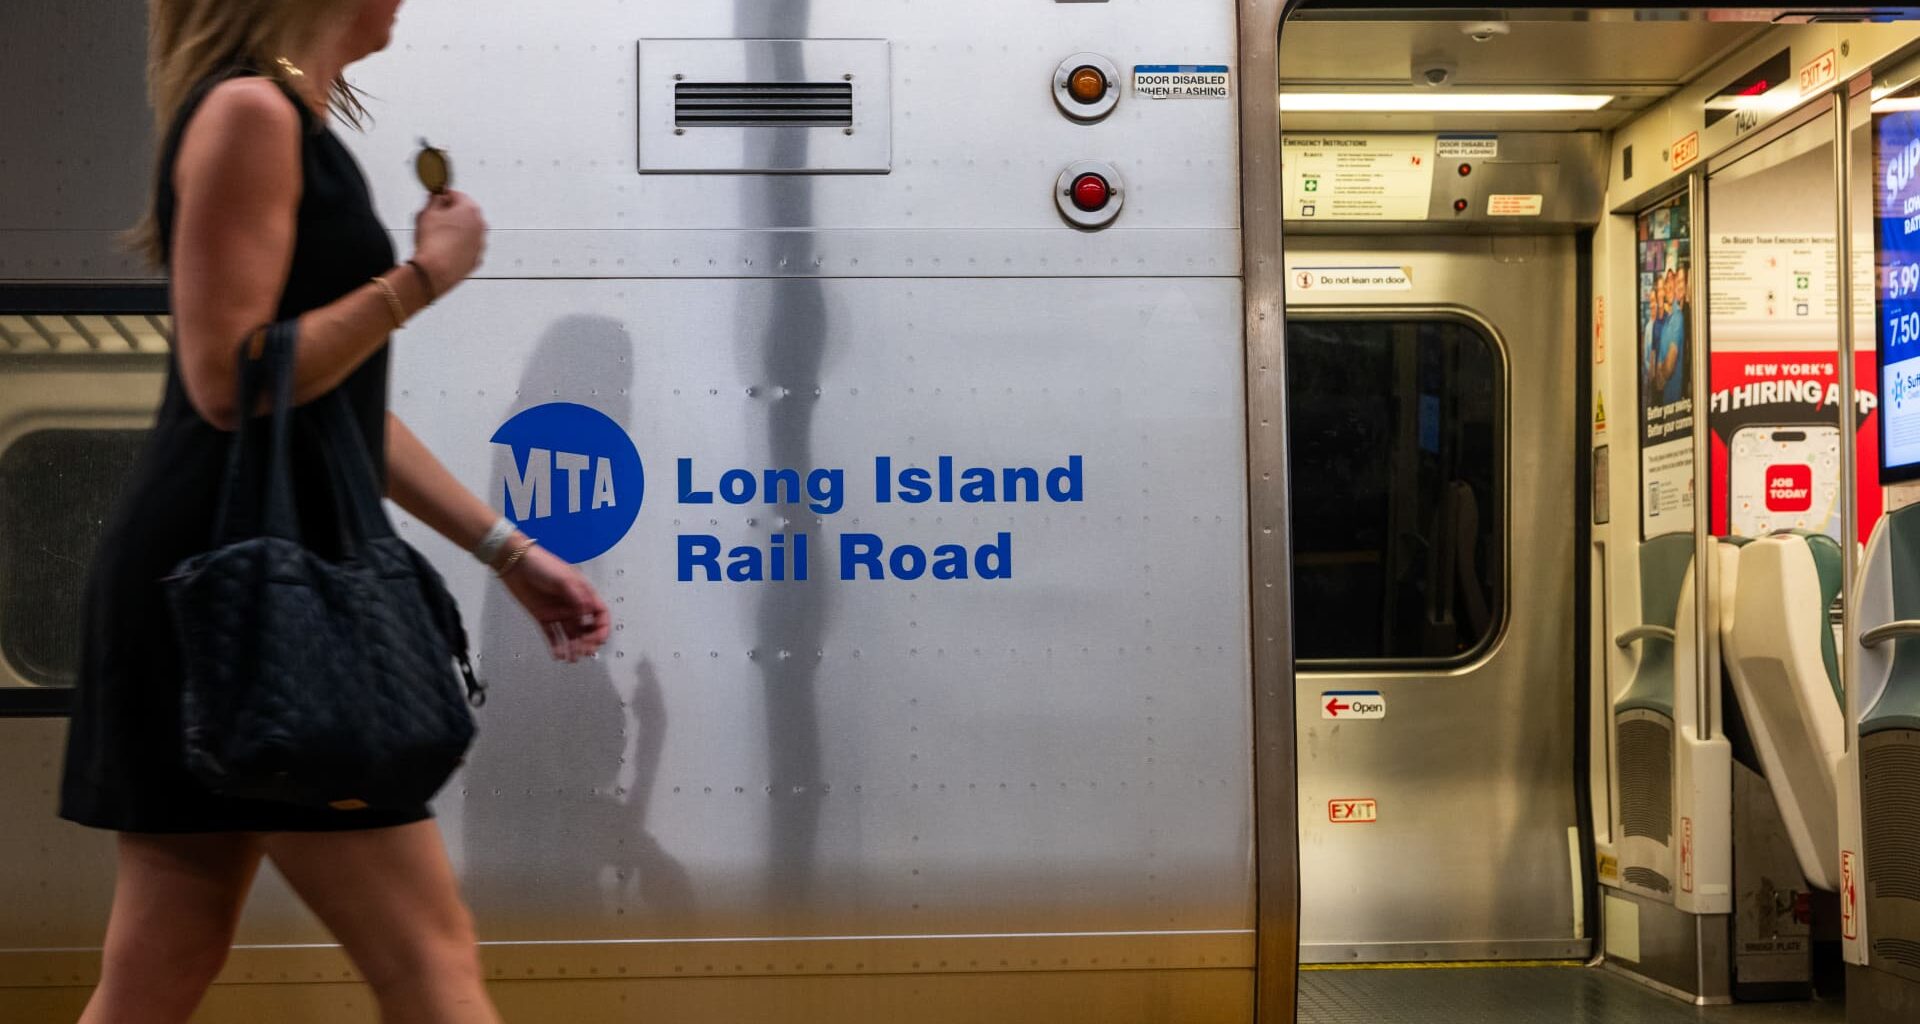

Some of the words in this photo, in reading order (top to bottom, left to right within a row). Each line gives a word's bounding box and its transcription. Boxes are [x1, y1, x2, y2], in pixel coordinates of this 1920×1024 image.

[1137, 76, 1169, 84] DOOR
[1173, 76, 1226, 84] DISABLED
[1801, 63, 1820, 89] EXIT
[1320, 276, 1333, 284] Do
[1335, 276, 1350, 284] not
[1351, 276, 1370, 284] lean
[1385, 275, 1406, 284] door
[1889, 262, 1920, 299] 5.99
[1889, 311, 1920, 347] 7.50
[1744, 364, 1778, 376] NEW
[1781, 363, 1834, 375] YORK'S
[1732, 379, 1823, 410] HIRING
[489, 441, 616, 522] MTA
[677, 457, 844, 515] Long
[875, 454, 1083, 503] Island
[1770, 478, 1793, 488] JOB
[1769, 489, 1808, 499] TODAY
[677, 534, 808, 582] Rail
[840, 531, 1012, 580] Road
[1352, 702, 1383, 714] Open
[1331, 803, 1374, 819] EXIT
